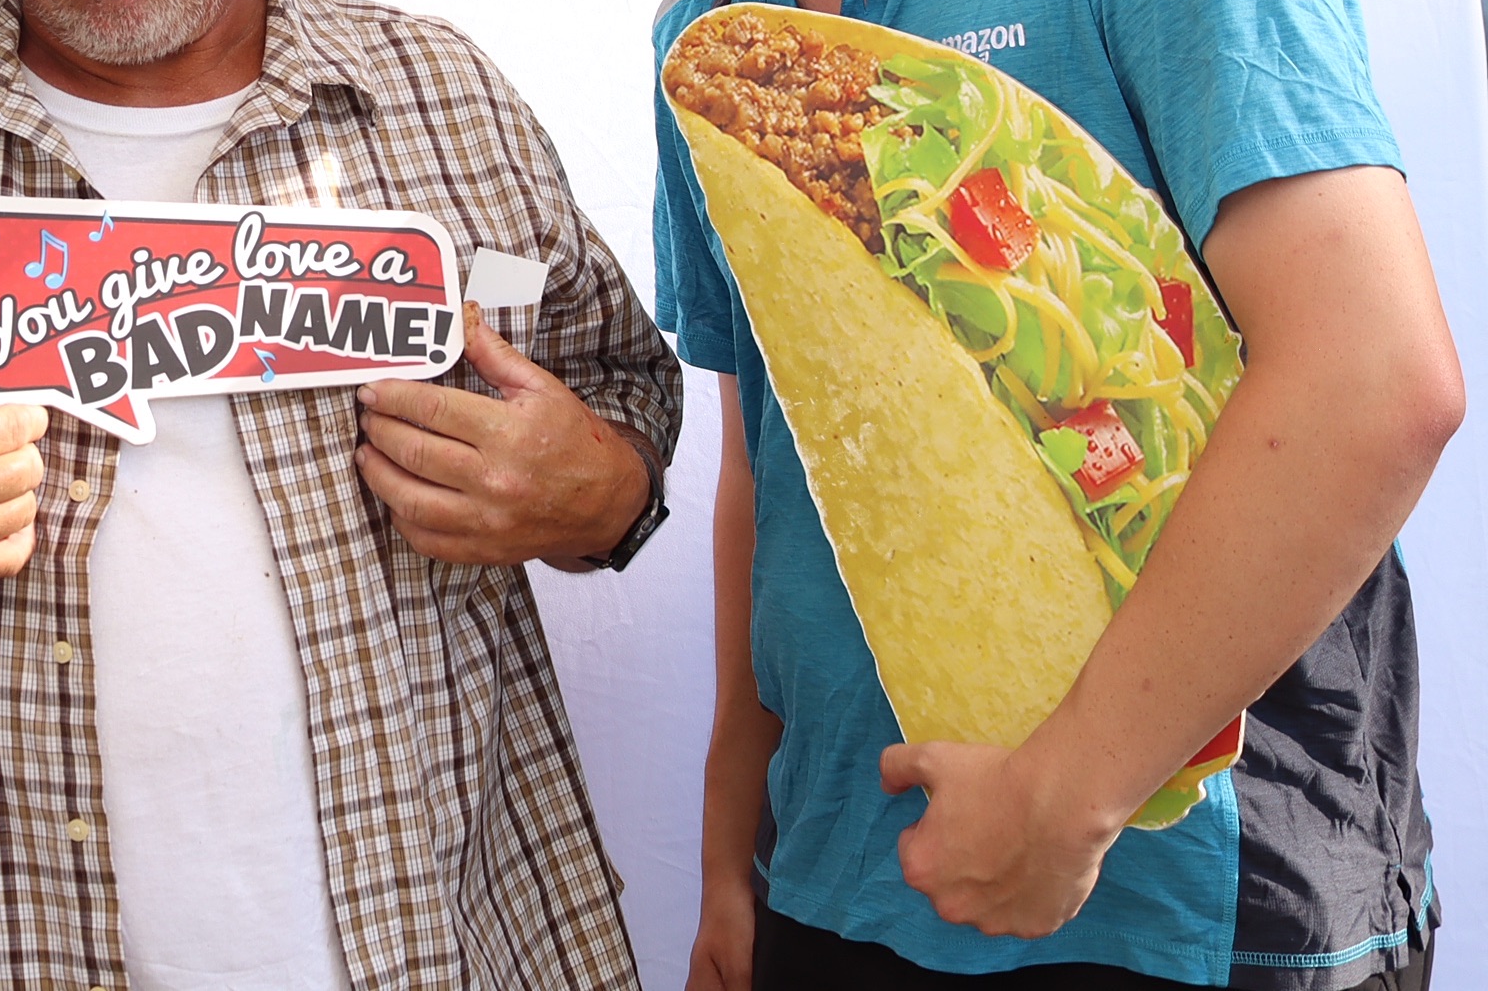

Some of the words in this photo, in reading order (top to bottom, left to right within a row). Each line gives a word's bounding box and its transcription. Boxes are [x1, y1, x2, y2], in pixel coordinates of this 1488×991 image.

[936, 22, 1026, 53] mazon
[102, 249, 225, 336] give
[233, 212, 362, 279] love
[371, 248, 416, 283] a
[64, 309, 235, 405] BAD
[239, 285, 454, 365] NAME!
